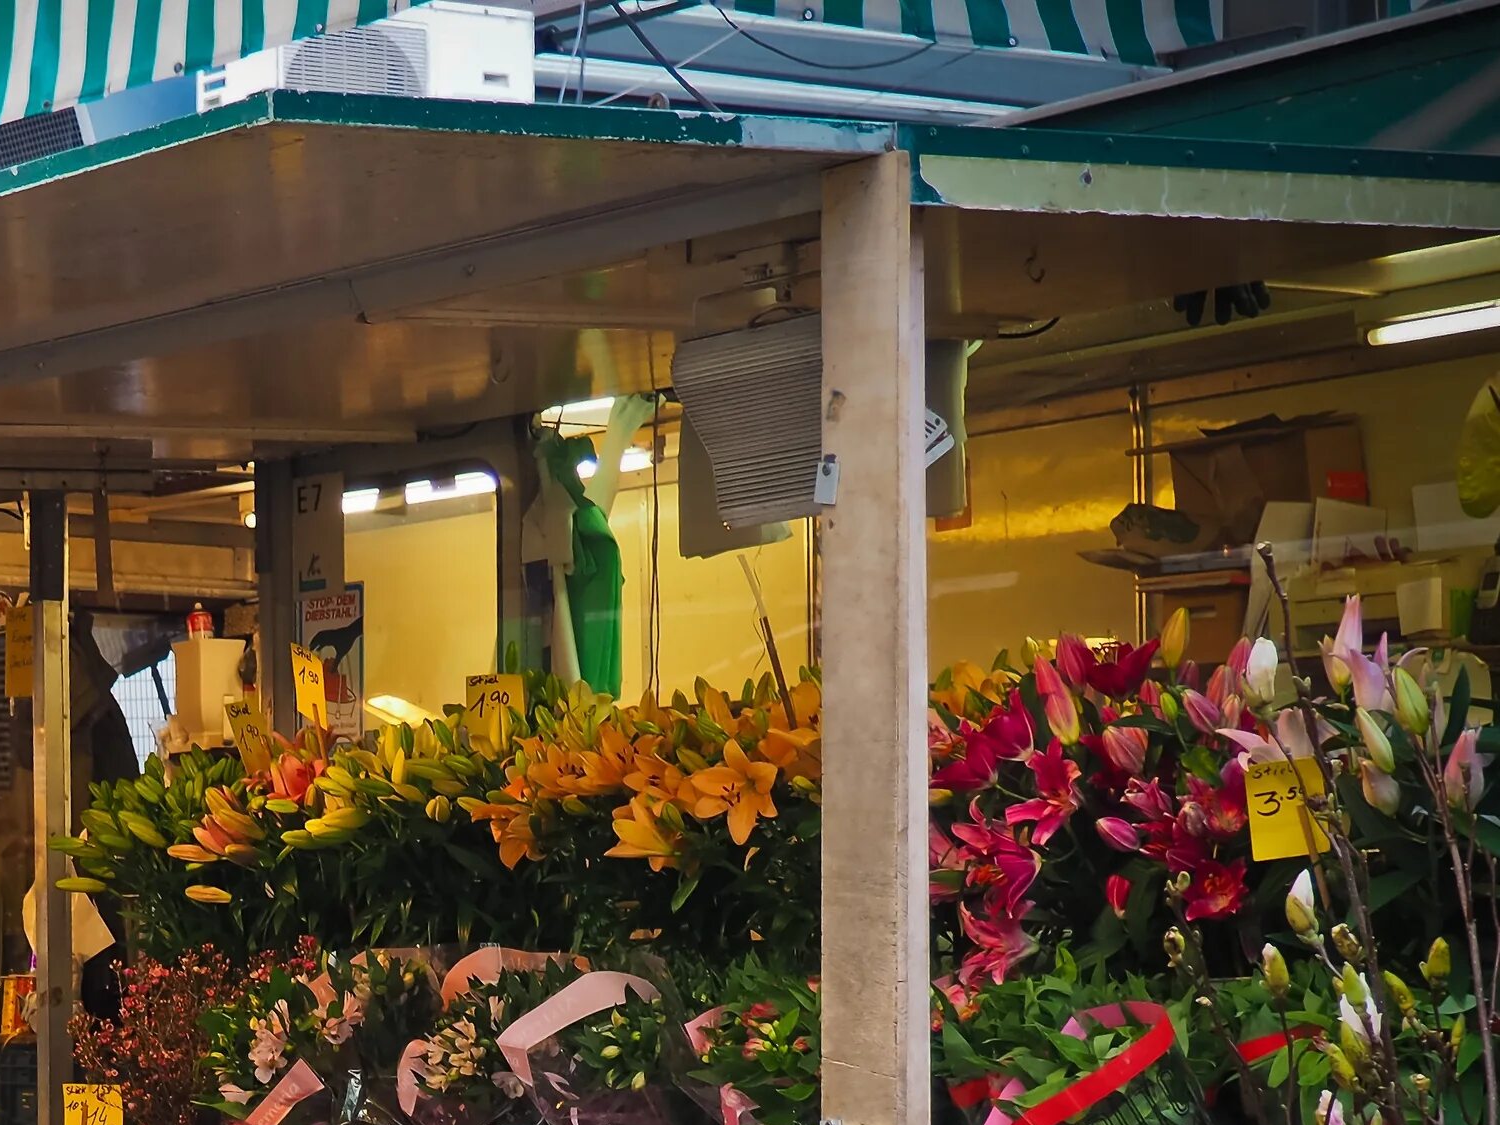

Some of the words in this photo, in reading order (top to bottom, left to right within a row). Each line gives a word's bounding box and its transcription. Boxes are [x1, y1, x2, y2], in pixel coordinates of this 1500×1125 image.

[297, 484, 322, 514] E7
[336, 595, 356, 607] DEM
[305, 607, 357, 621] DIEBSTAHL!
[1252, 769, 1293, 784] Stiel
